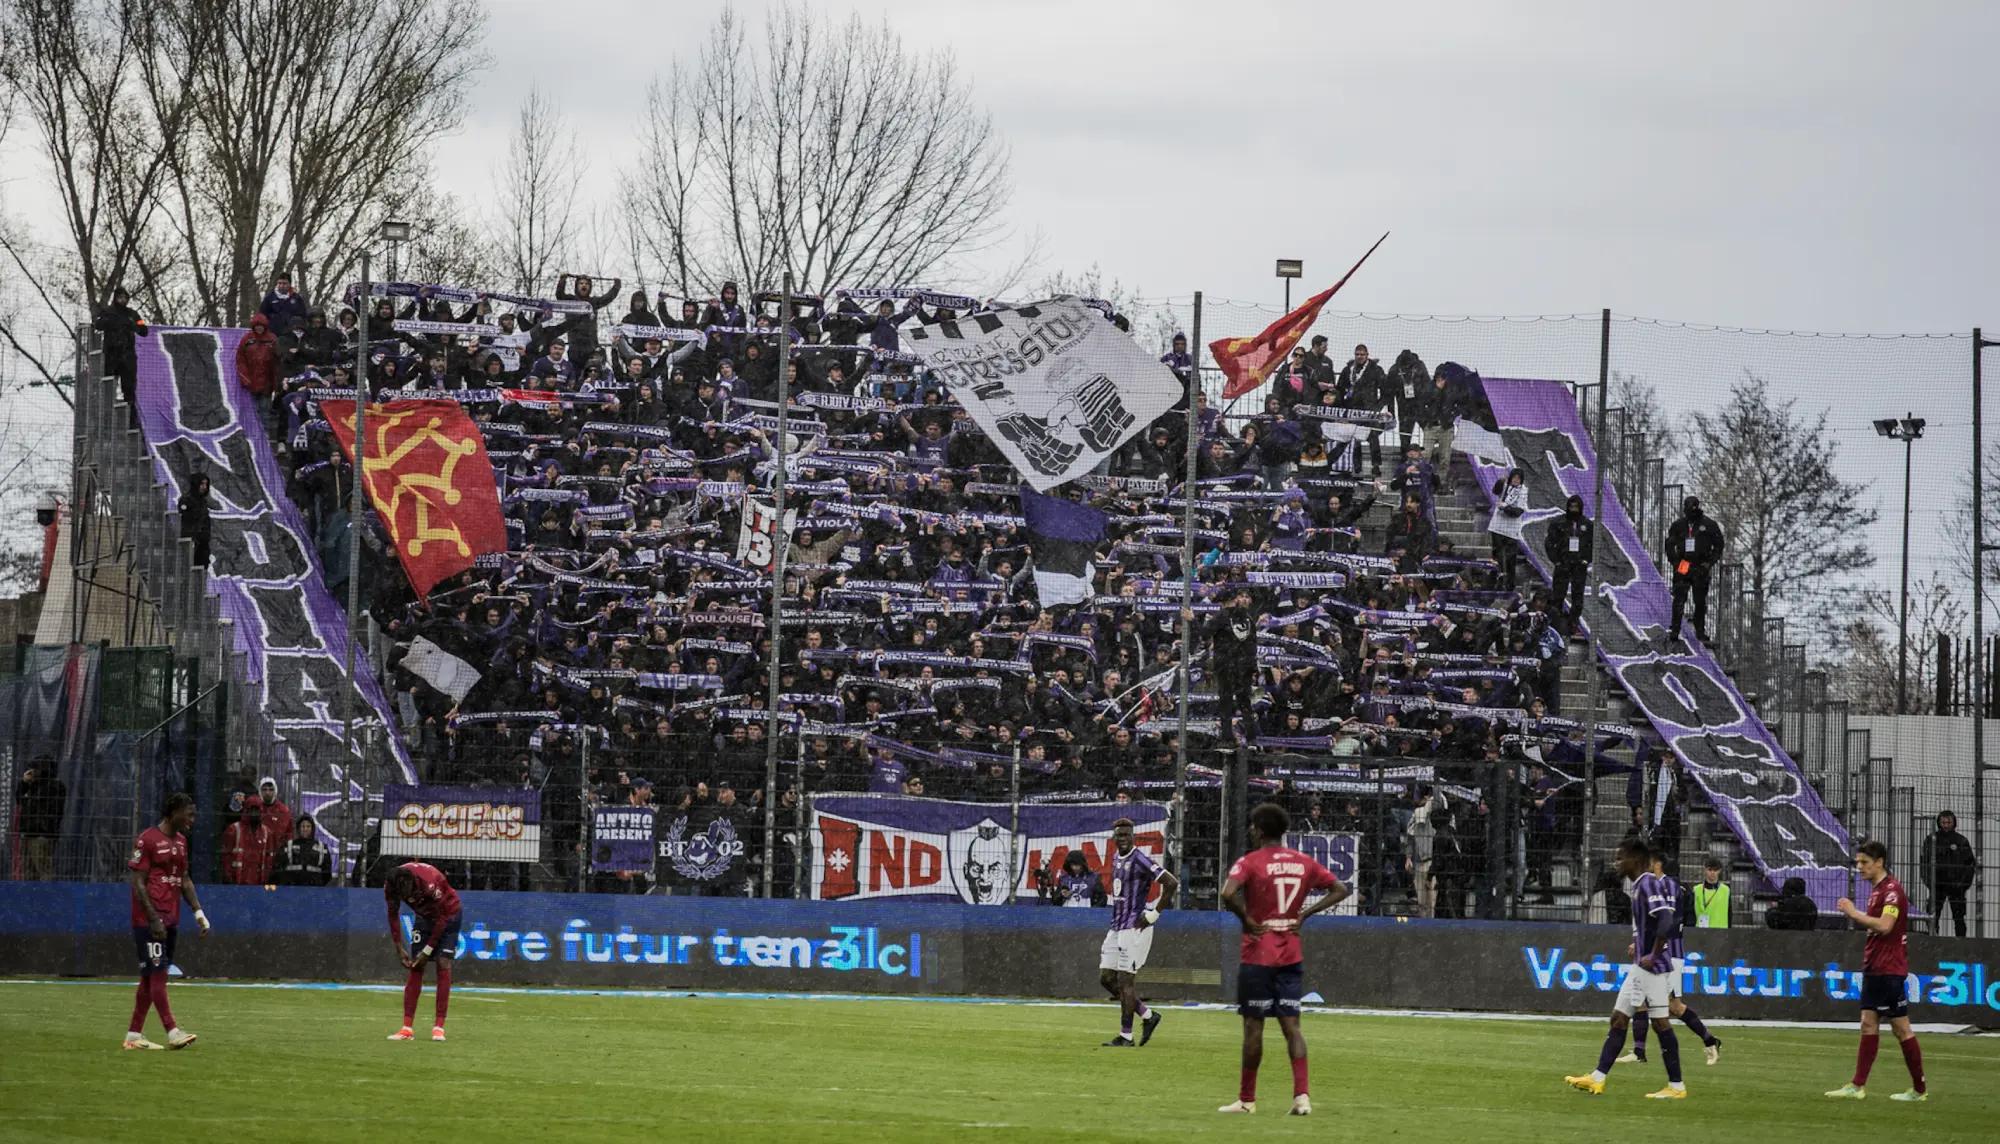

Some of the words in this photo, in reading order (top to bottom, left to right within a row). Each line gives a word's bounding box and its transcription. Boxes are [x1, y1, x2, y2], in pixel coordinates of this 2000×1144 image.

[816, 518, 852, 528] VIOLA
[735, 580, 773, 589] VIOLA
[687, 614, 751, 624] TOULOUSE
[1382, 619, 1411, 627] FOOTBALL
[1412, 619, 1427, 627] CLUB
[1511, 655, 1538, 667] BRICE
[1594, 722, 1637, 737] TOULOUS
[398, 802, 524, 841] OCCIFANS
[595, 813, 653, 828] ANTHO
[595, 829, 653, 841] PRESENT
[659, 840, 689, 857] BT
[718, 840, 744, 856] 02
[1272, 877, 1302, 914] 17
[563, 918, 698, 964] futur
[147, 942, 162, 958] 10
